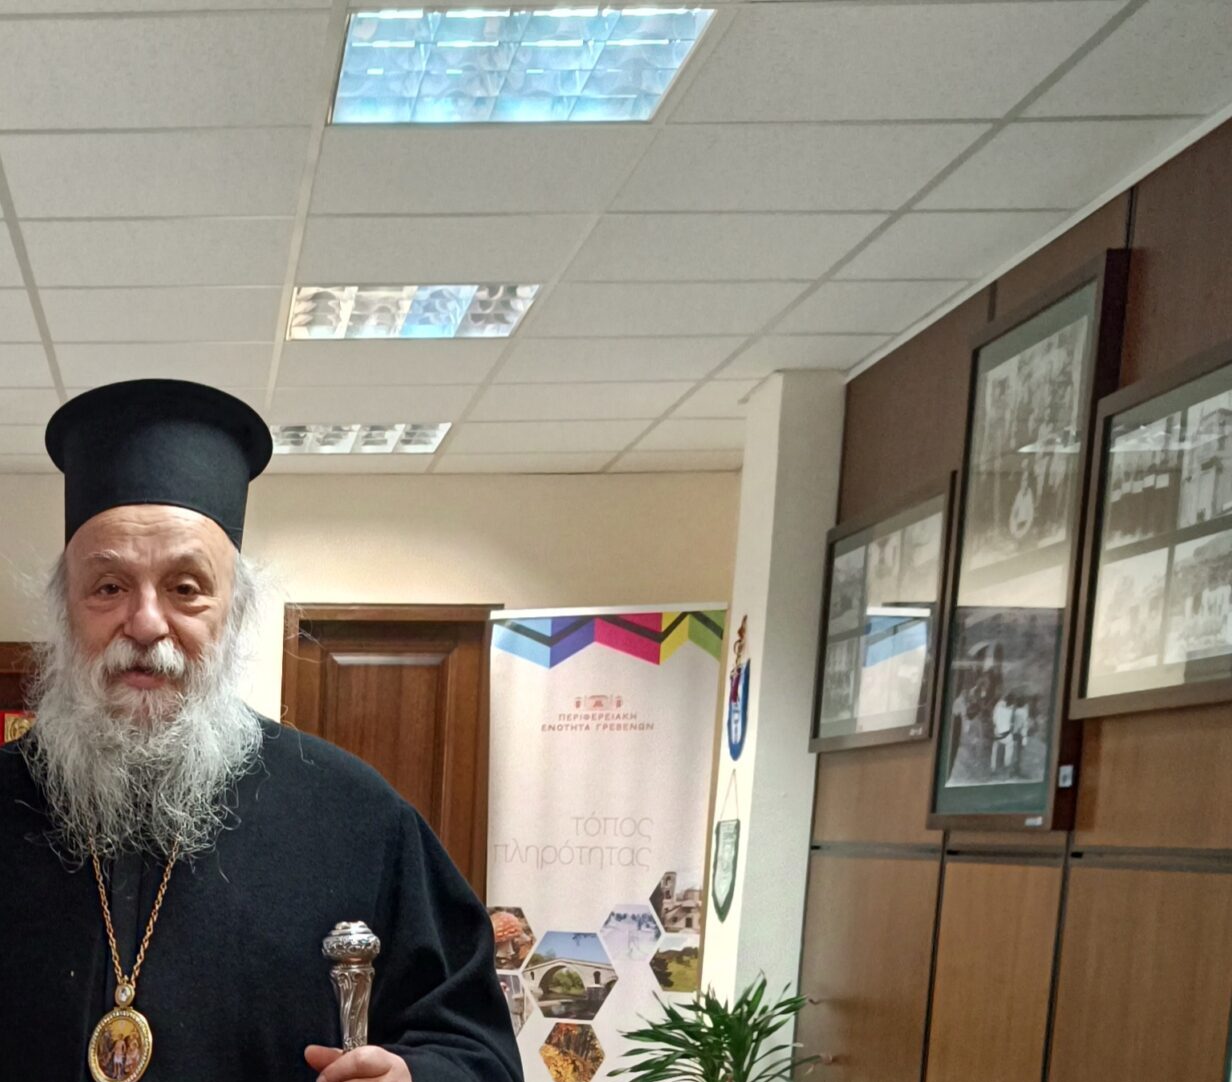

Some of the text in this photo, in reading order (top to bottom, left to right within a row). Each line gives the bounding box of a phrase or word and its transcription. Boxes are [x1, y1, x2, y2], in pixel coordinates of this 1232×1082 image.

[558, 713, 637, 721] ΠΕΡΙΦΕΡΕΙΑΚΗ
[541, 723, 655, 732] ΕΝΟΤΗΤΑ ΓΡΕΒΕΝΩΝ
[572, 812, 653, 841] τόπος
[493, 838, 652, 869] πληρότητας
